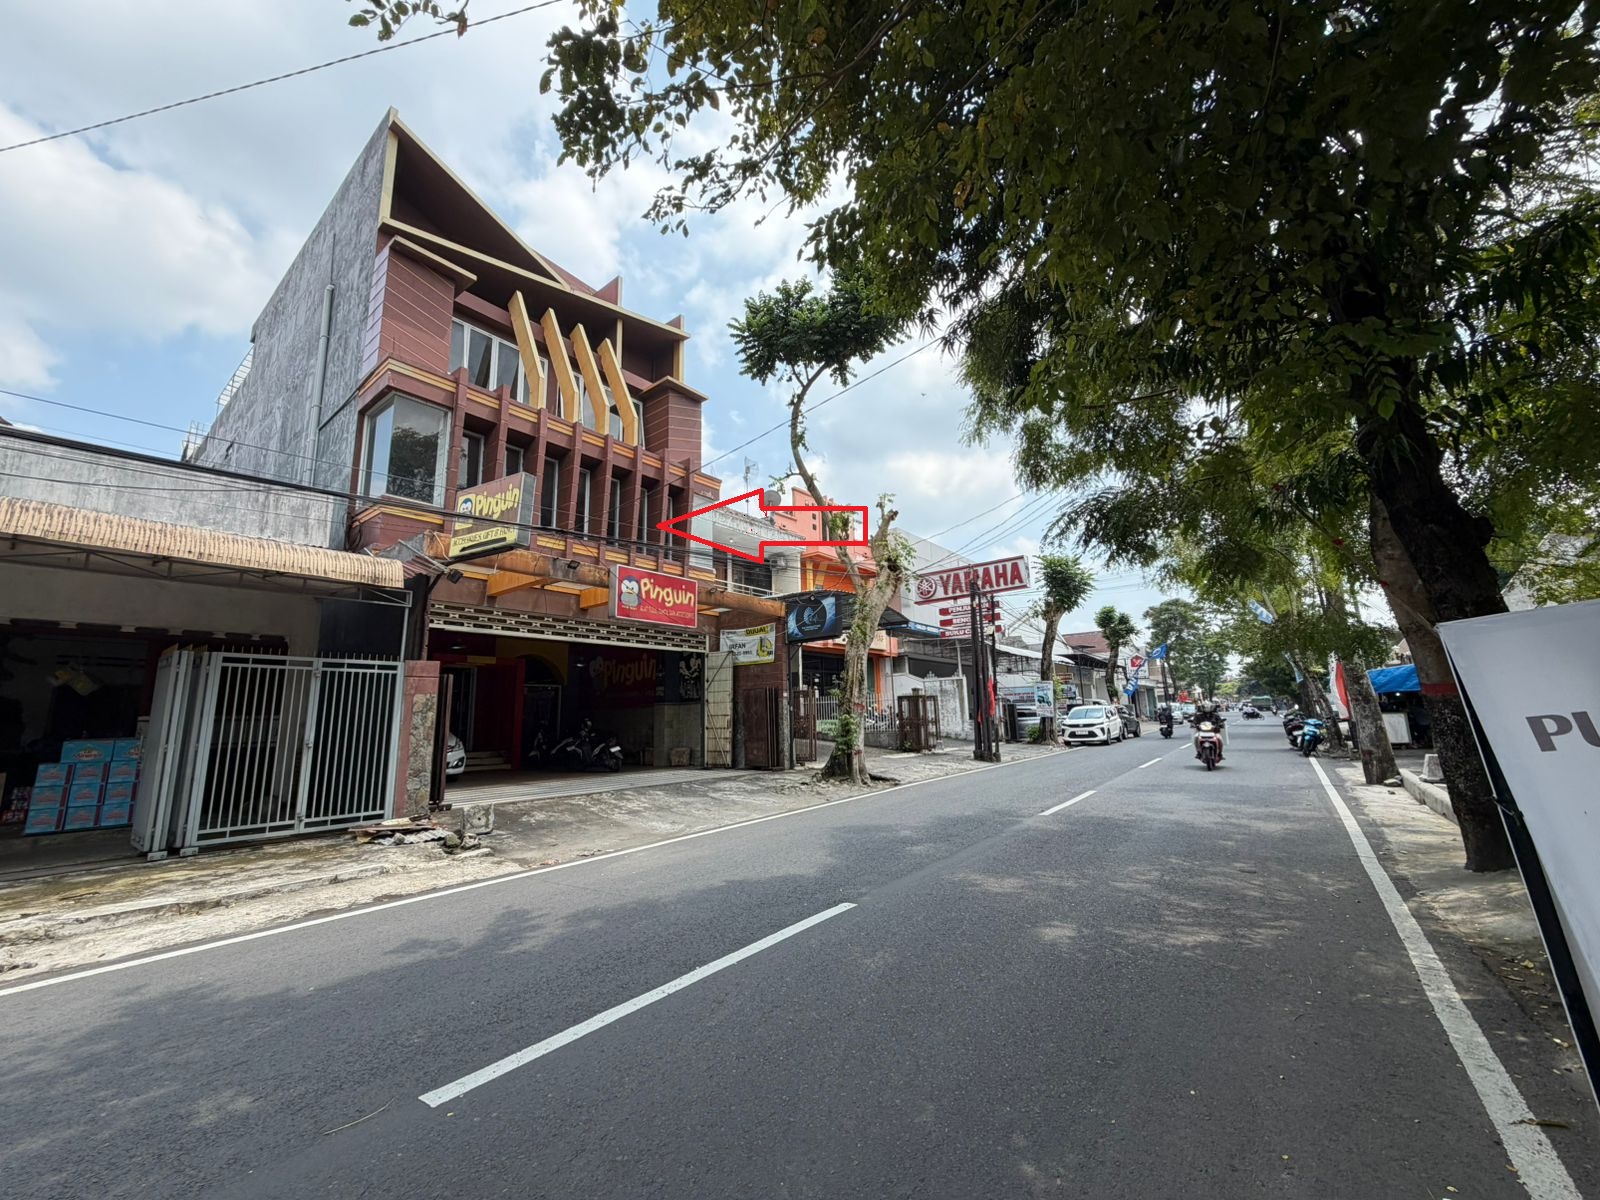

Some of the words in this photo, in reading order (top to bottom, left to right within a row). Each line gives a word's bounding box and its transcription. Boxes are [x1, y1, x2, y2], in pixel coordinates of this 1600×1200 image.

[475, 483, 520, 519] Pinguin
[640, 577, 694, 607] Pinguin
[939, 562, 1024, 595] YAMAHA
